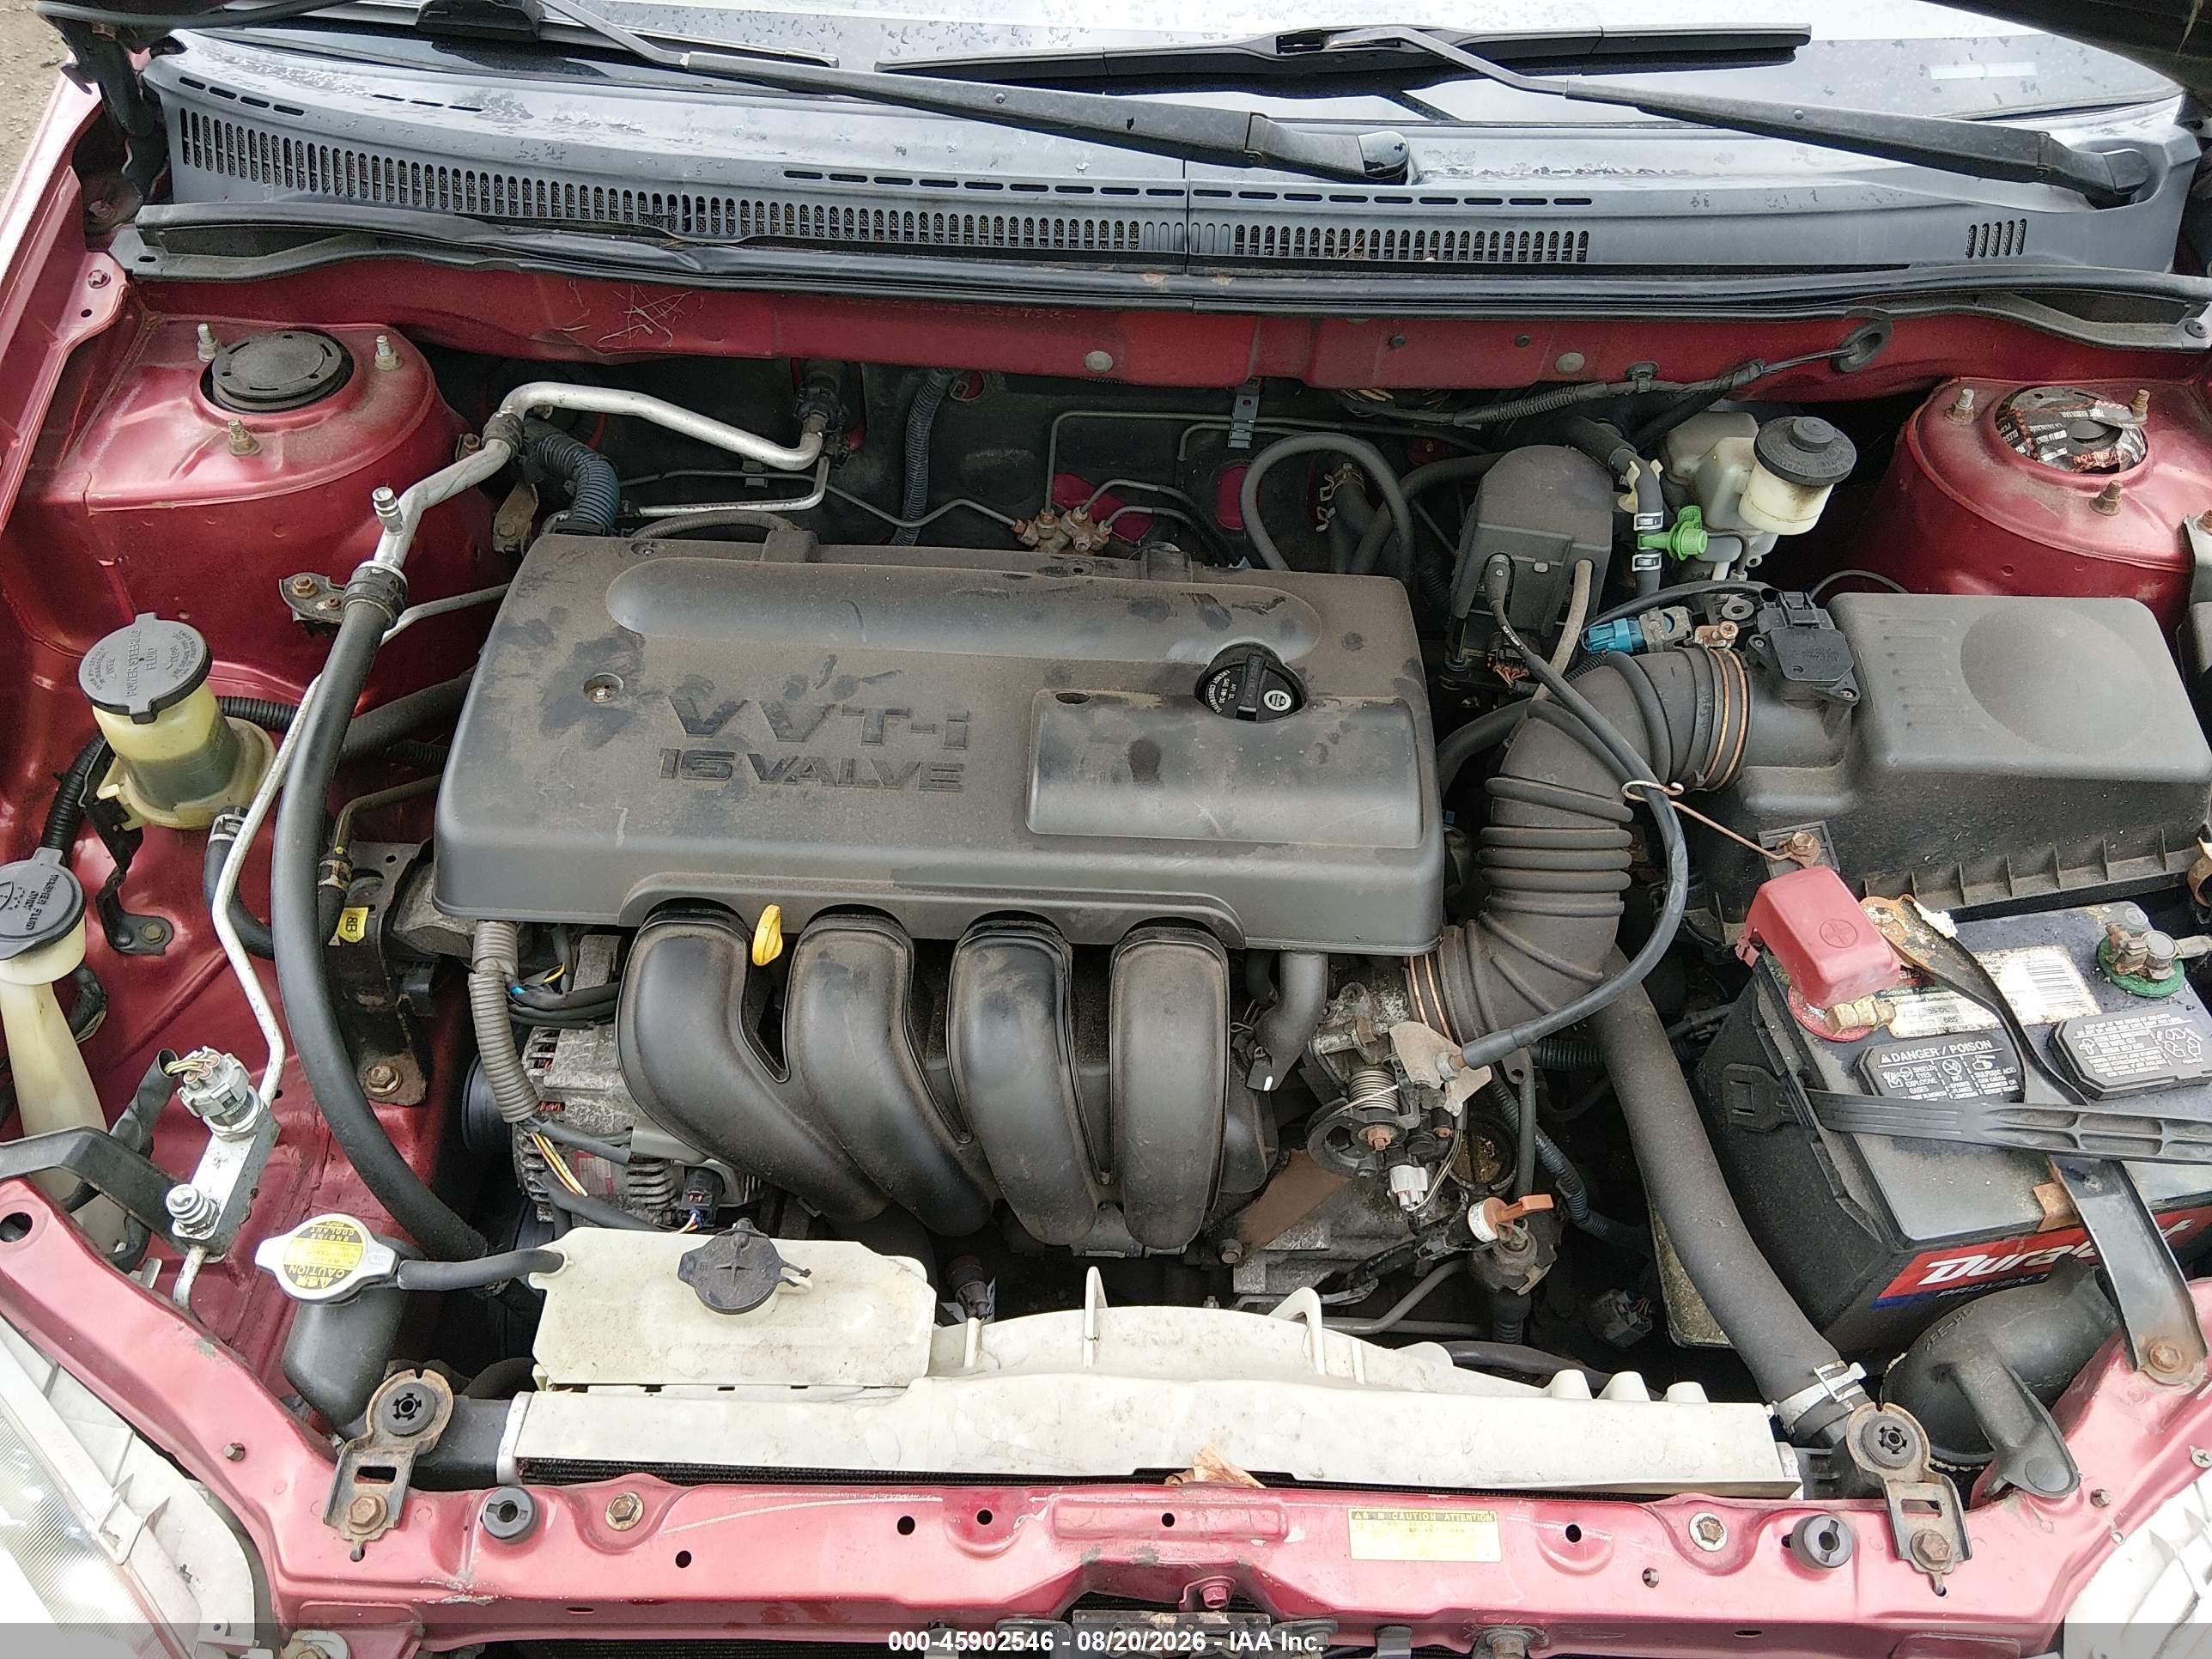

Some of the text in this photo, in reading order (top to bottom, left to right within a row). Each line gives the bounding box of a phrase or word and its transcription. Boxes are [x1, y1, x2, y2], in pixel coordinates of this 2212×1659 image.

[123, 629, 142, 697] POWER STEERING
[145, 646, 158, 671] FLUID
[658, 747, 965, 793] 16 VALVE
[23, 890, 40, 911] ONLY
[24, 873, 59, 932] WASHER FLUID
[345, 916, 359, 933] 8B
[1890, 1048, 1940, 1063] DANGER
[1948, 1039, 1993, 1054] POISON
[308, 1226, 356, 1237] COOLANT
[288, 1264, 346, 1279] CAUTION
[1391, 1511, 1437, 1521] CAUTION
[1443, 1513, 1493, 1522] ATTENTION
